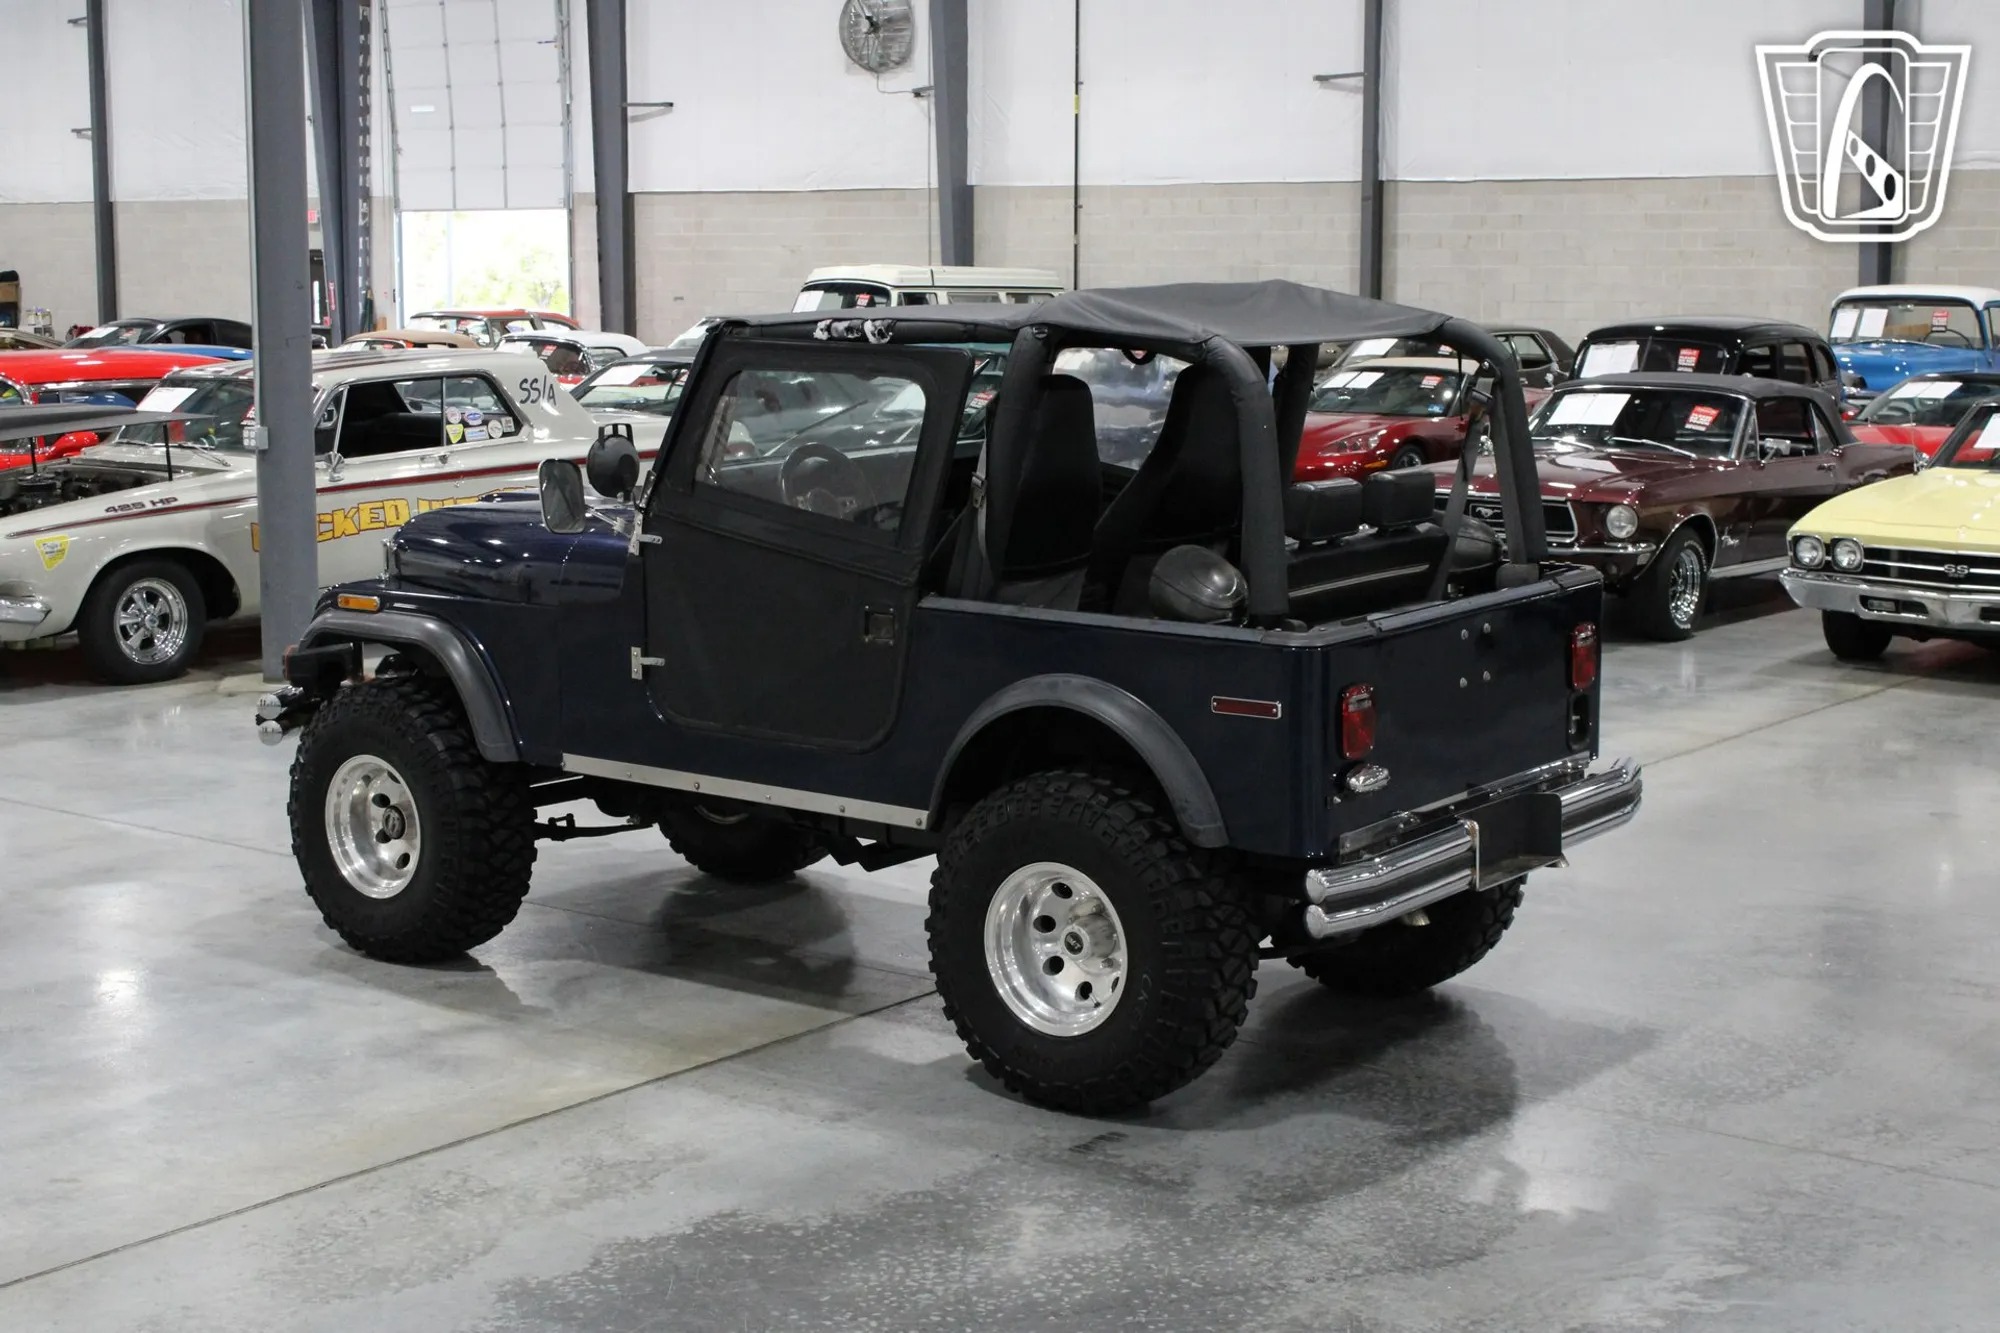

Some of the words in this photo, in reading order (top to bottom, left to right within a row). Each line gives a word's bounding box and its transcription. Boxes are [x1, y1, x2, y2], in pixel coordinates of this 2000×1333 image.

[519, 374, 557, 406] SS/A
[149, 496, 179, 507] HP
[251, 498, 411, 552] CKED
[1944, 564, 1969, 574] SS
